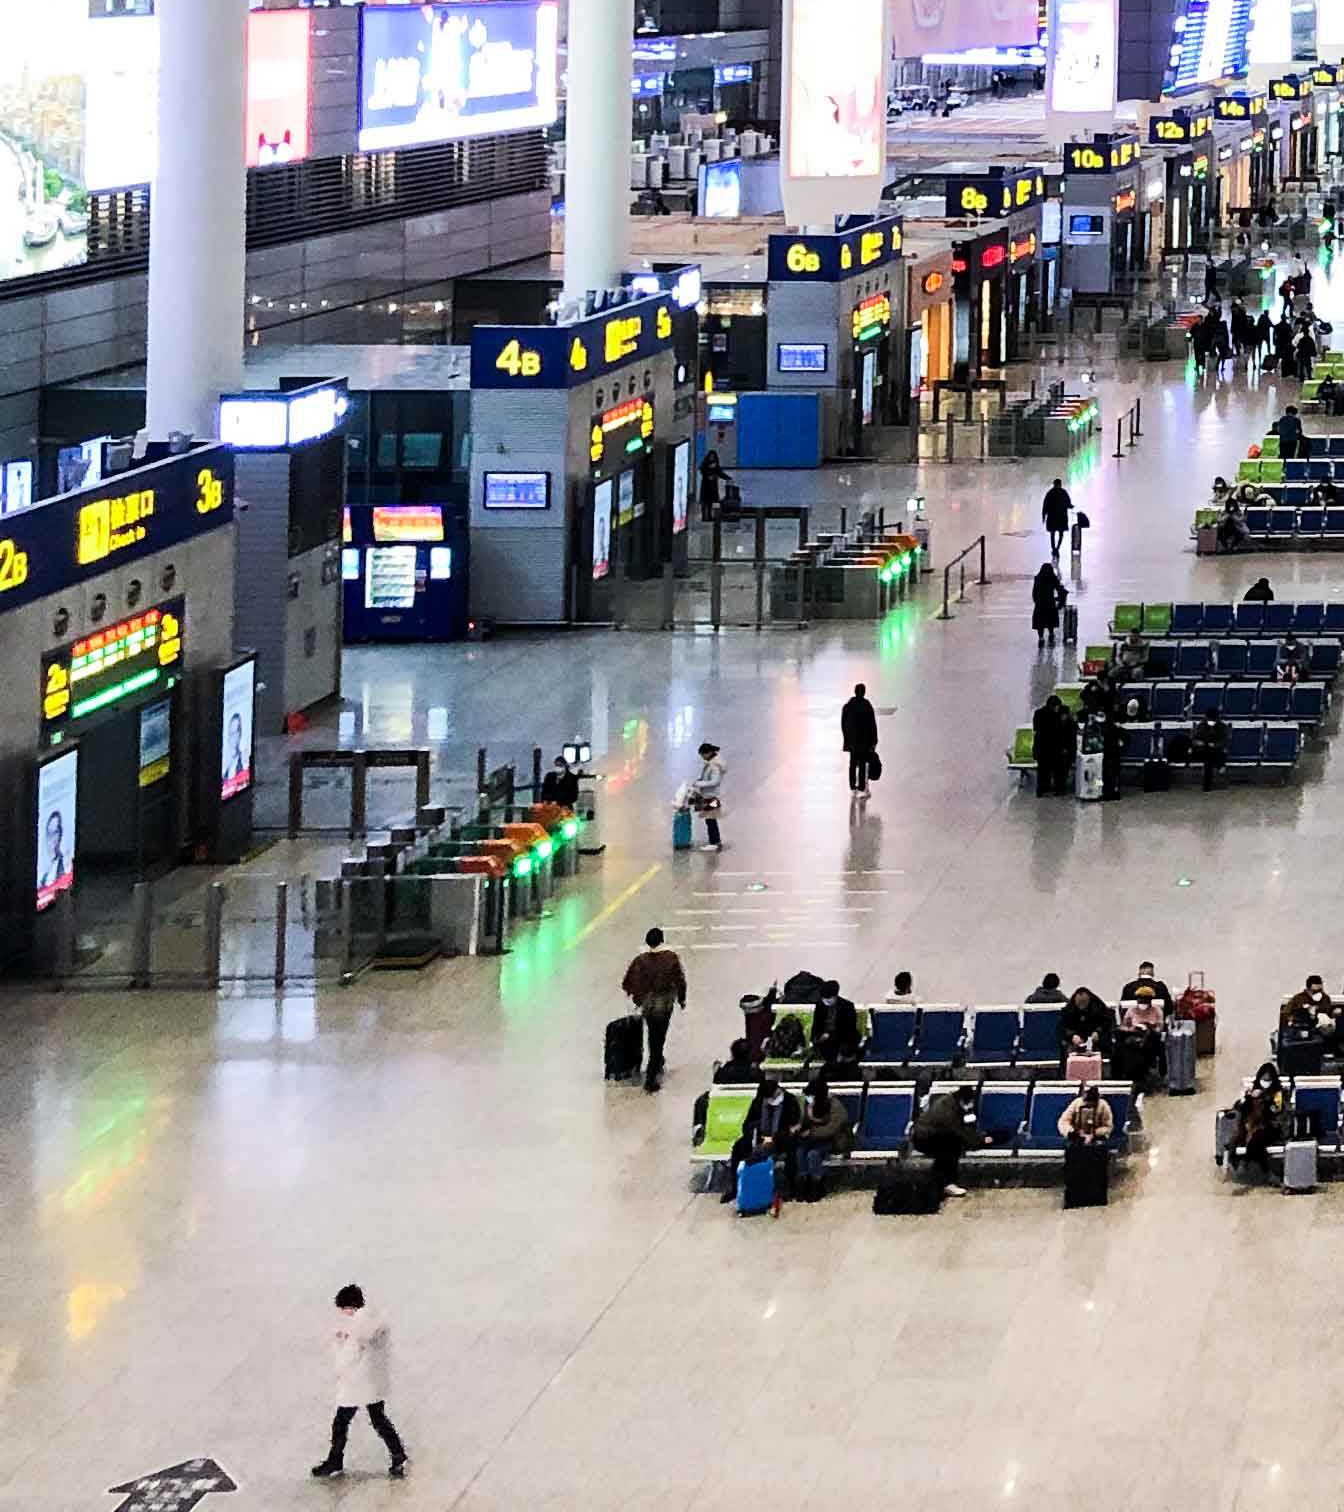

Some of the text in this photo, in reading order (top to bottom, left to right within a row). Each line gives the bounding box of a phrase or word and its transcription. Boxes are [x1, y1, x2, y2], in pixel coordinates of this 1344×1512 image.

[786, 242, 820, 272] 6B
[495, 339, 541, 376] 4B
[196, 469, 222, 514] 3B
